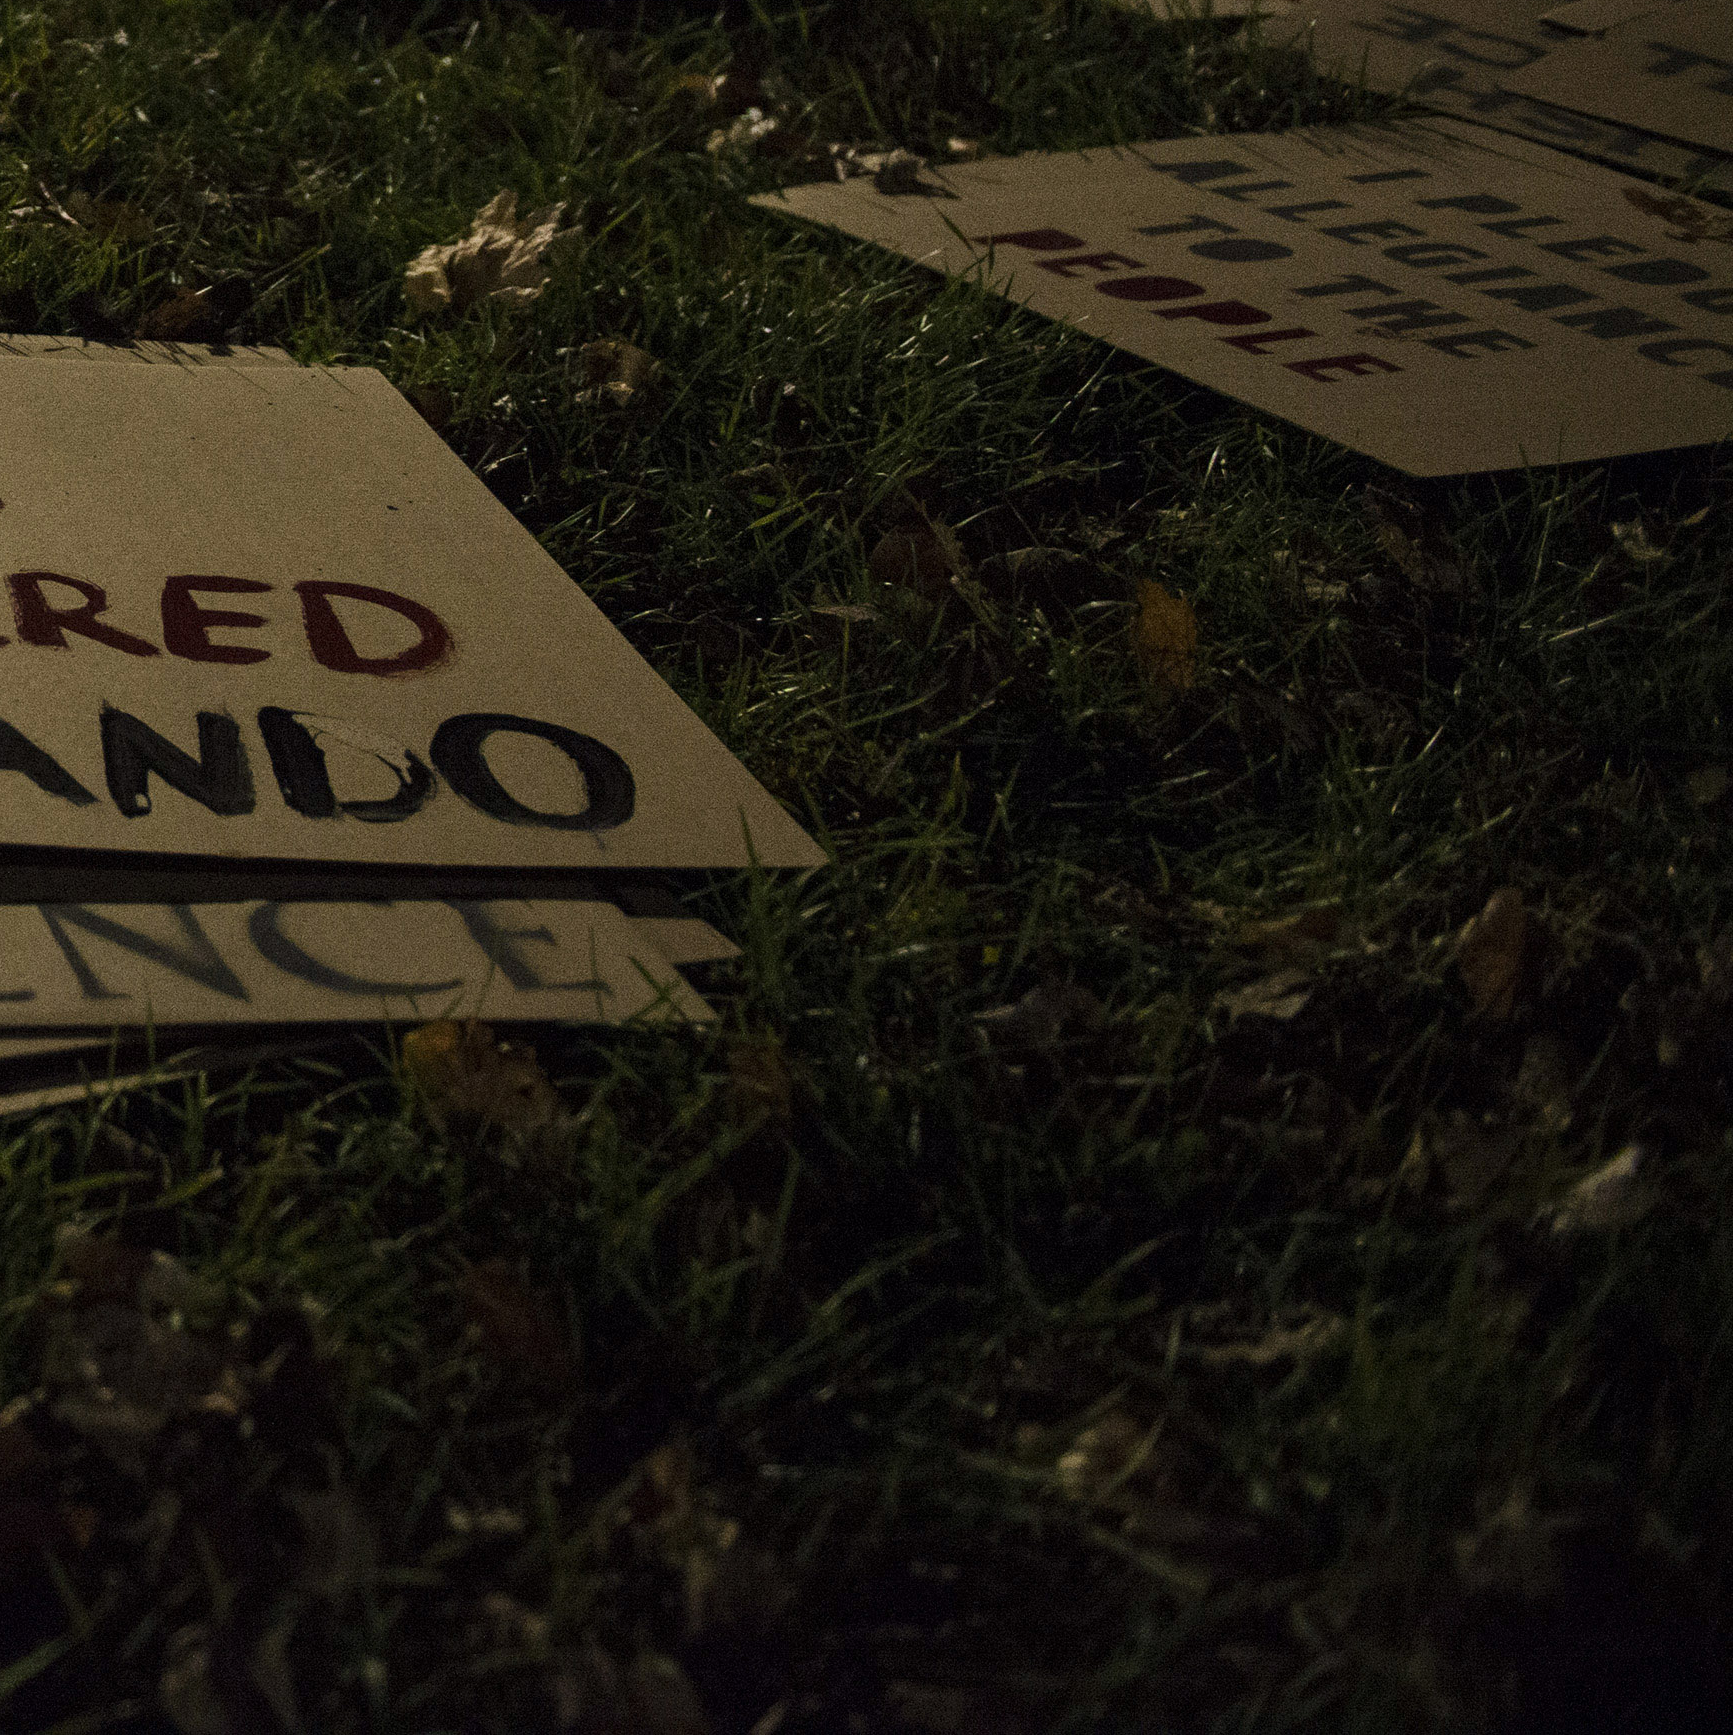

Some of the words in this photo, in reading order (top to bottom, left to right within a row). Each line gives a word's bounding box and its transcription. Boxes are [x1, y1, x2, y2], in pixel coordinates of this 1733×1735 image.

[975, 226, 1403, 383] PEOPLE
[1136, 213, 1294, 263] TO
[1290, 273, 1539, 360] THE
